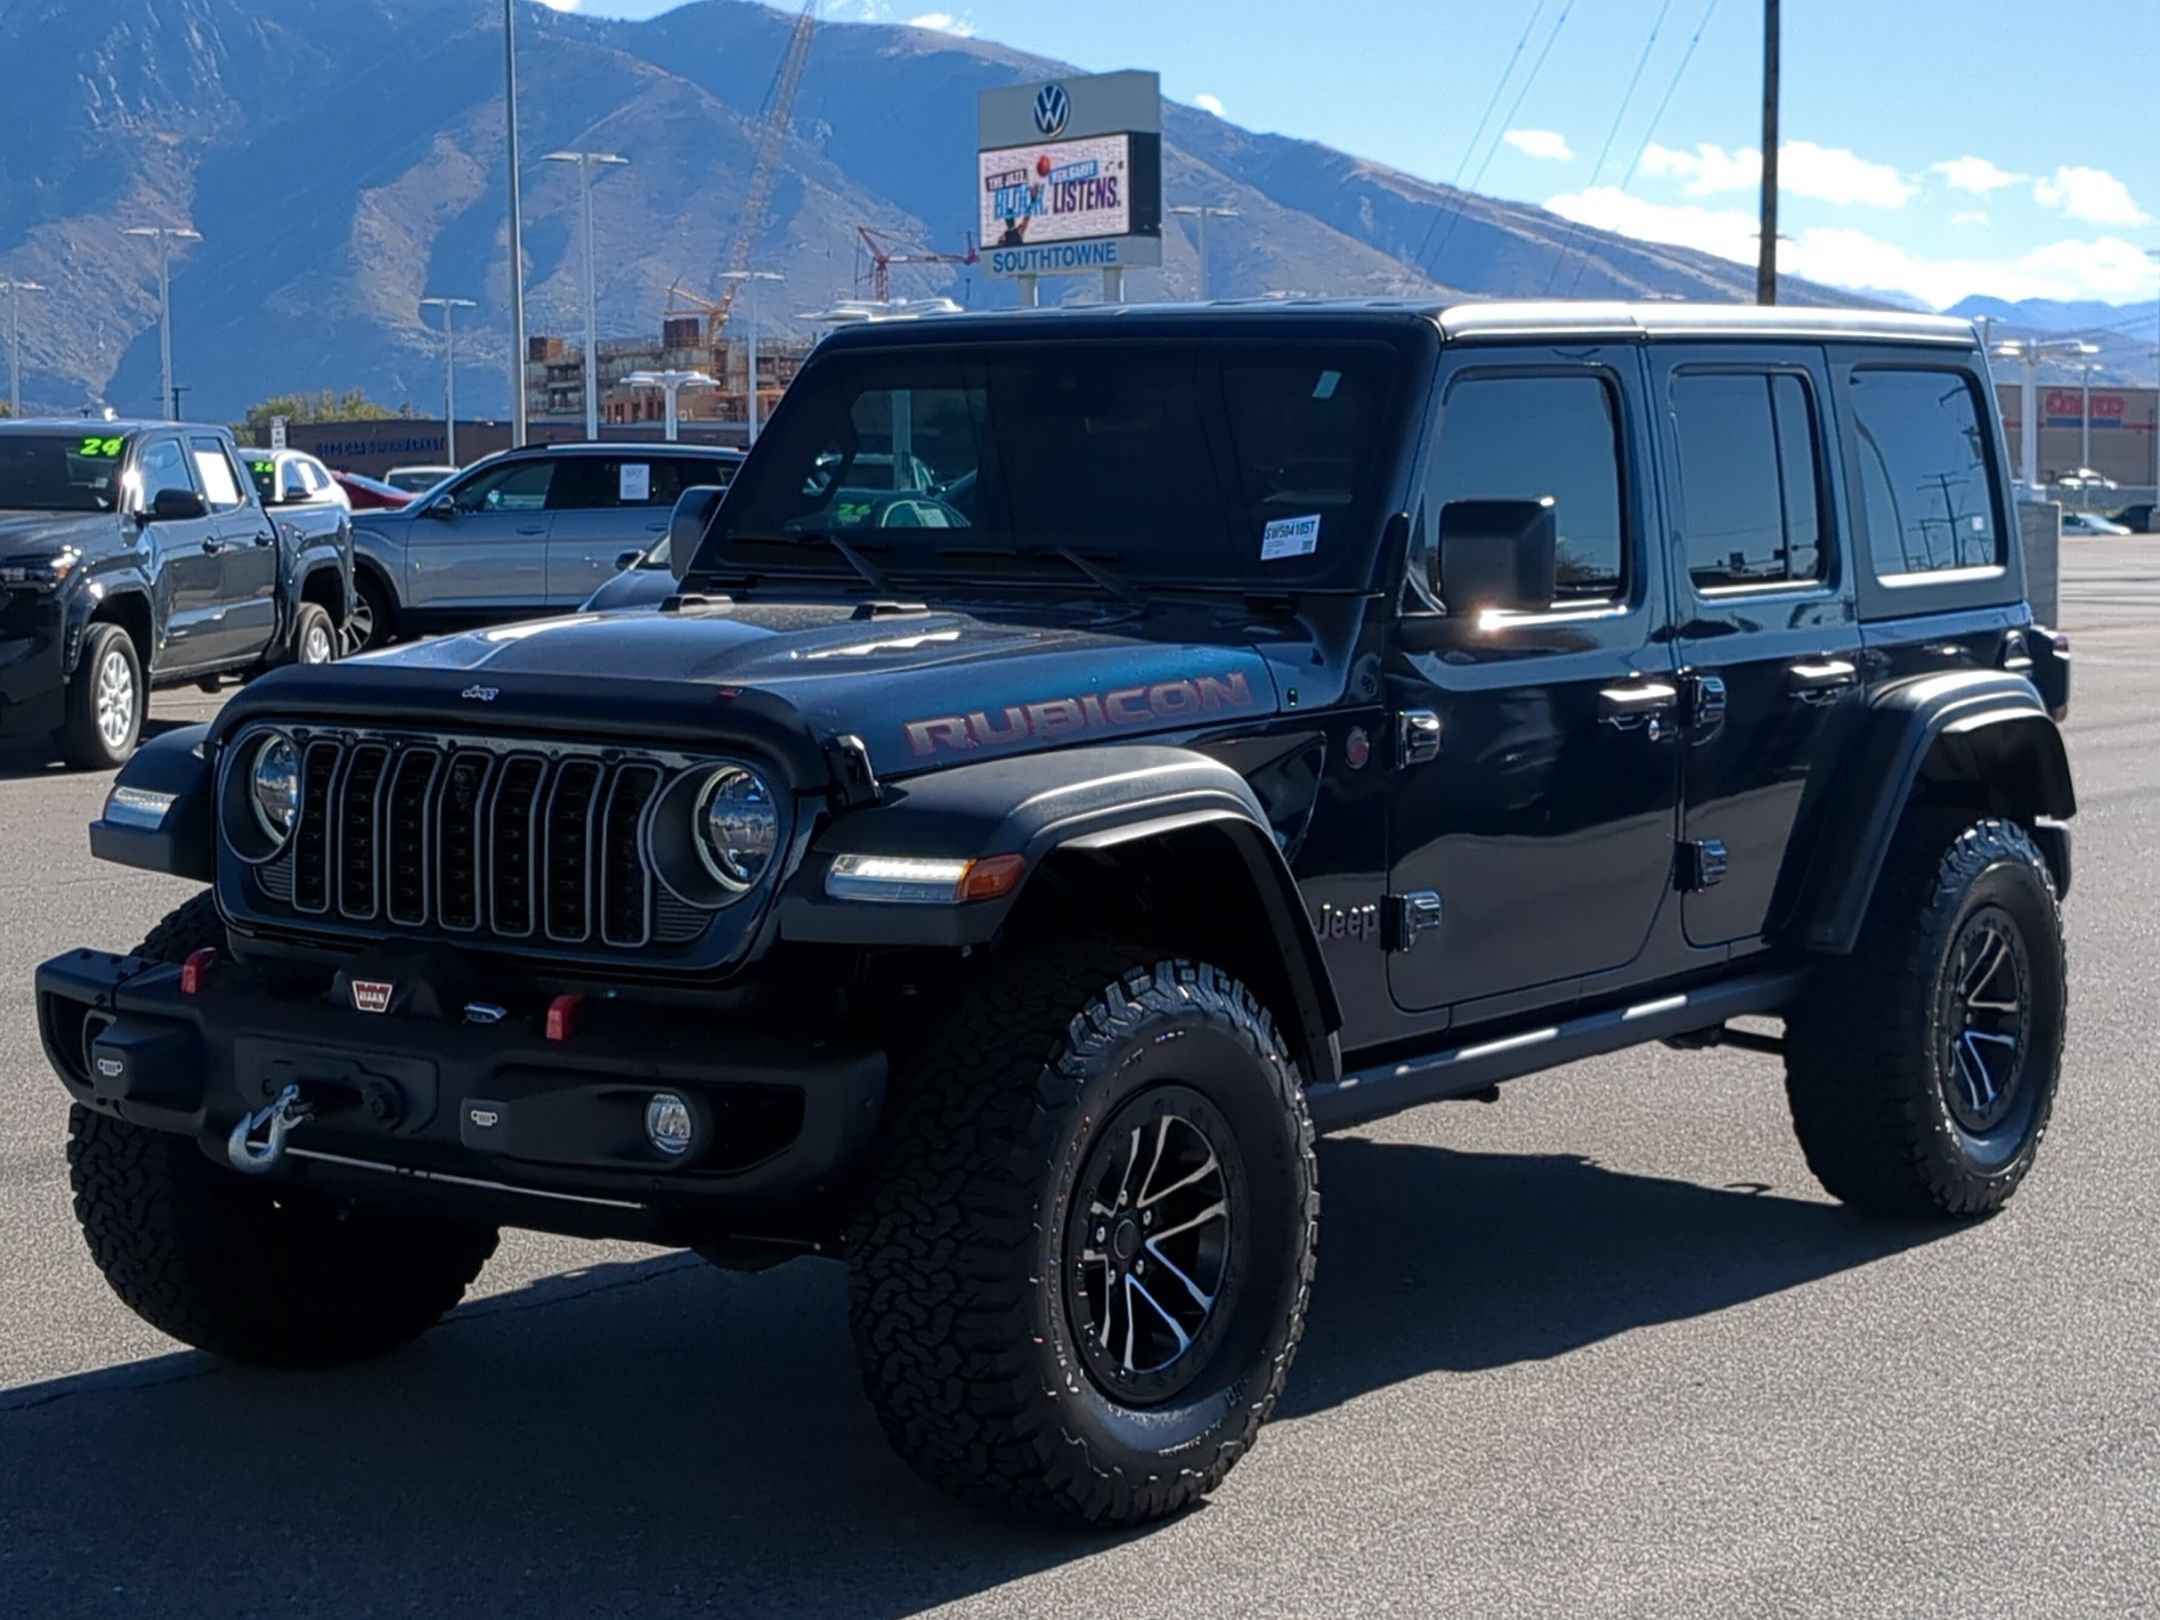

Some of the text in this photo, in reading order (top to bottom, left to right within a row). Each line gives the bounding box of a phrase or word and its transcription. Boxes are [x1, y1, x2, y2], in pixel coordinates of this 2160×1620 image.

[1053, 177, 1121, 214] LISTENS.
[992, 242, 1117, 273] SOUTHTOWNE
[80, 438, 122, 456] 24
[903, 672, 1252, 757] RUBICON
[1316, 903, 1379, 942] Jeep
